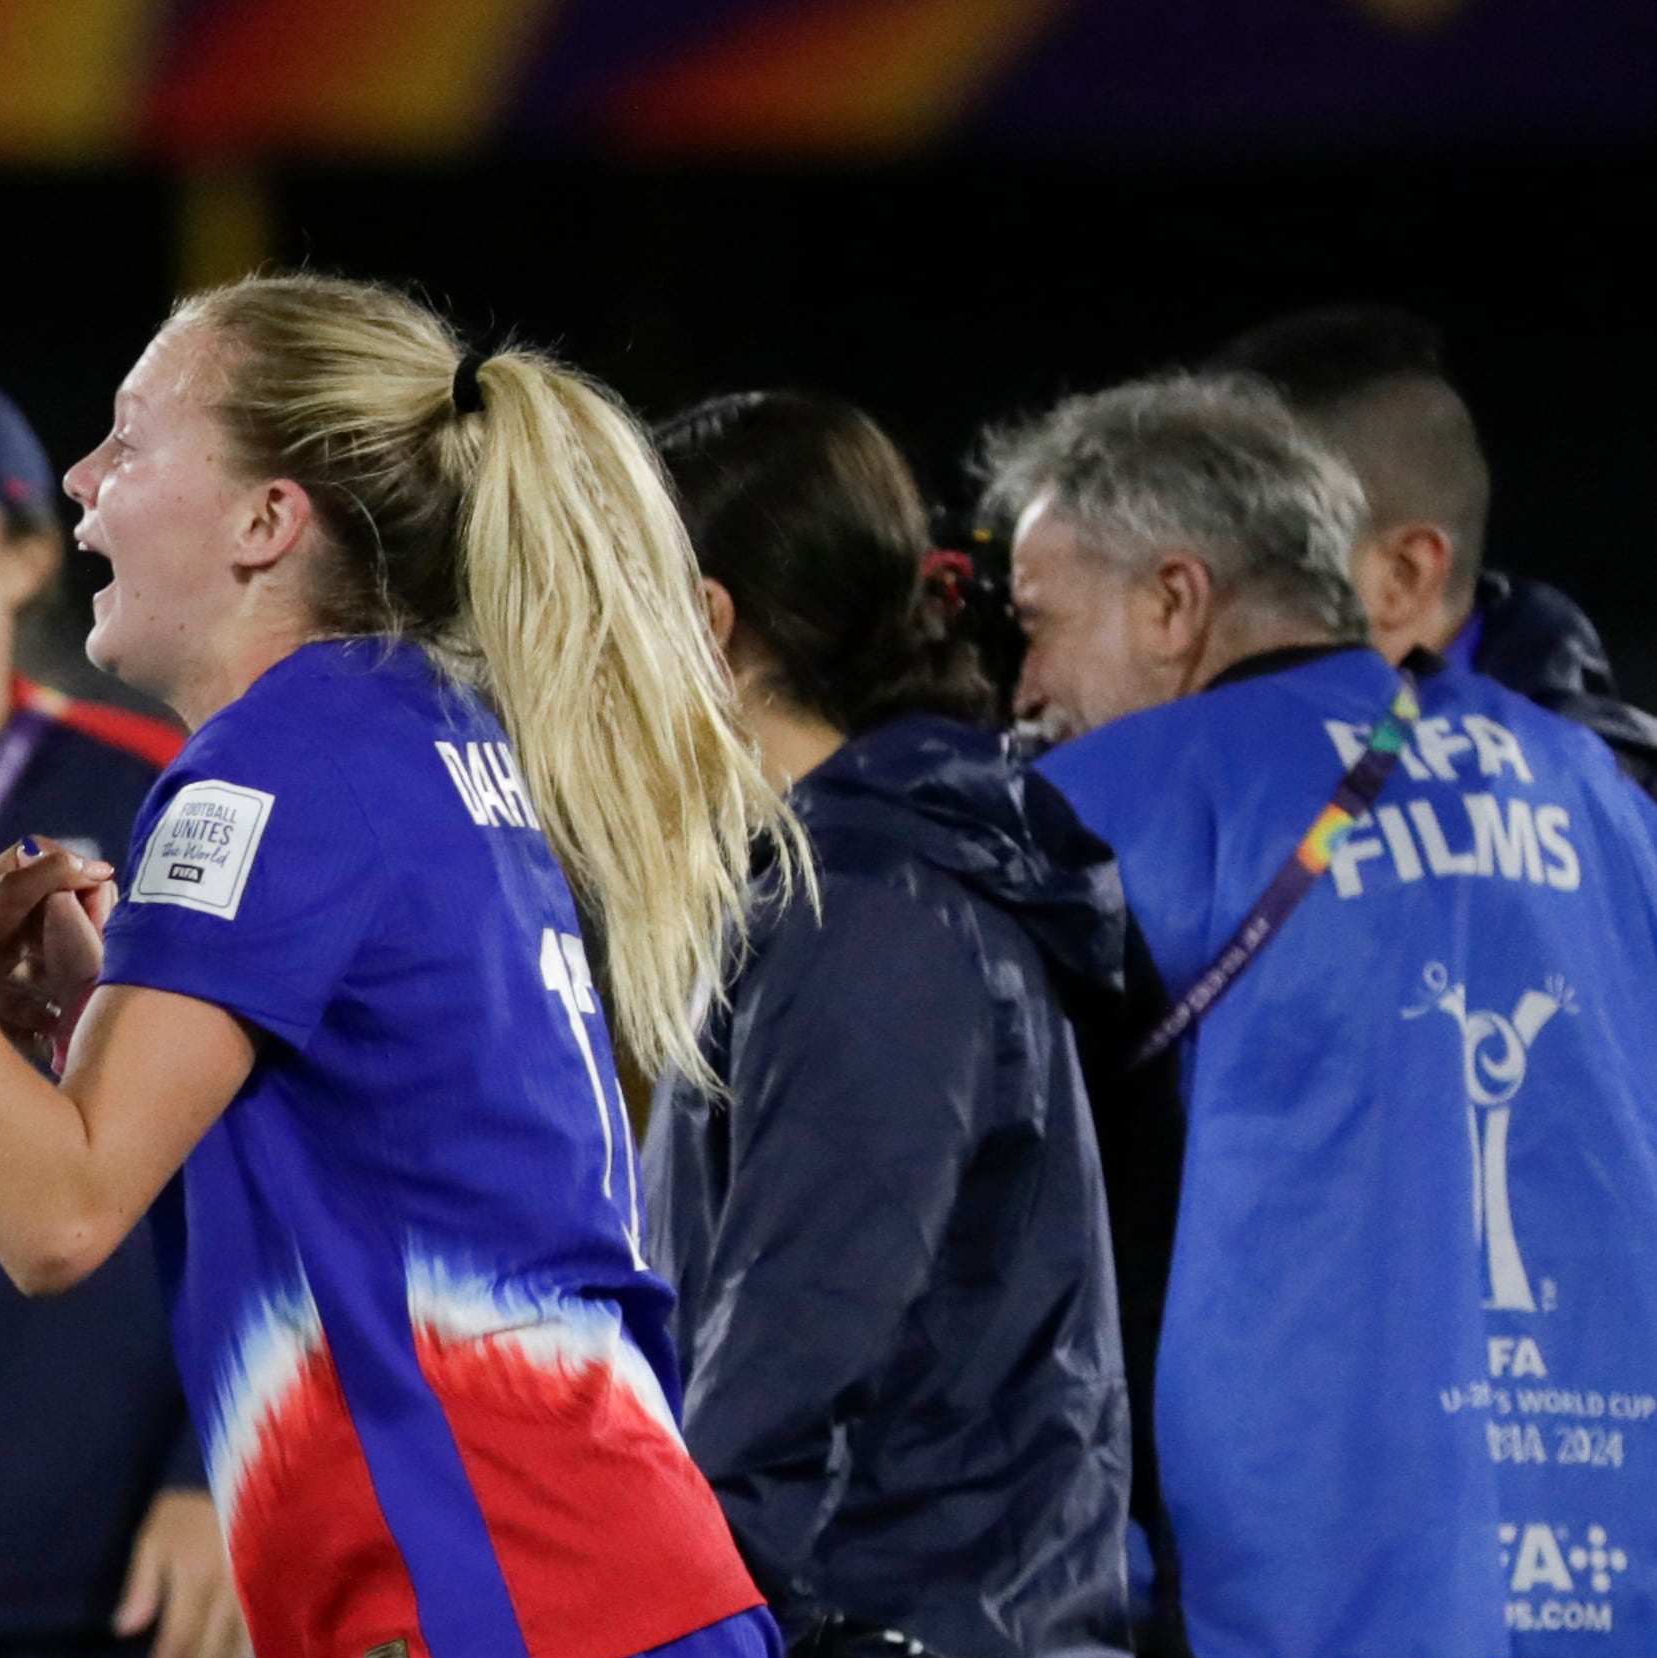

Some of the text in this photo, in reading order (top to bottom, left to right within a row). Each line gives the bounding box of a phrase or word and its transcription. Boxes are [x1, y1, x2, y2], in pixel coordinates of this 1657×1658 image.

[183, 802, 237, 825] FOOTBALL
[172, 819, 234, 846] UNITES
[1331, 793, 1581, 898] FILMS
[182, 842, 231, 868] World
[171, 867, 201, 882] FIFA
[1516, 1387, 1606, 1419] WORLD
[1608, 1390, 1657, 1420] CUP
[1555, 1426, 1625, 1469] 2024
